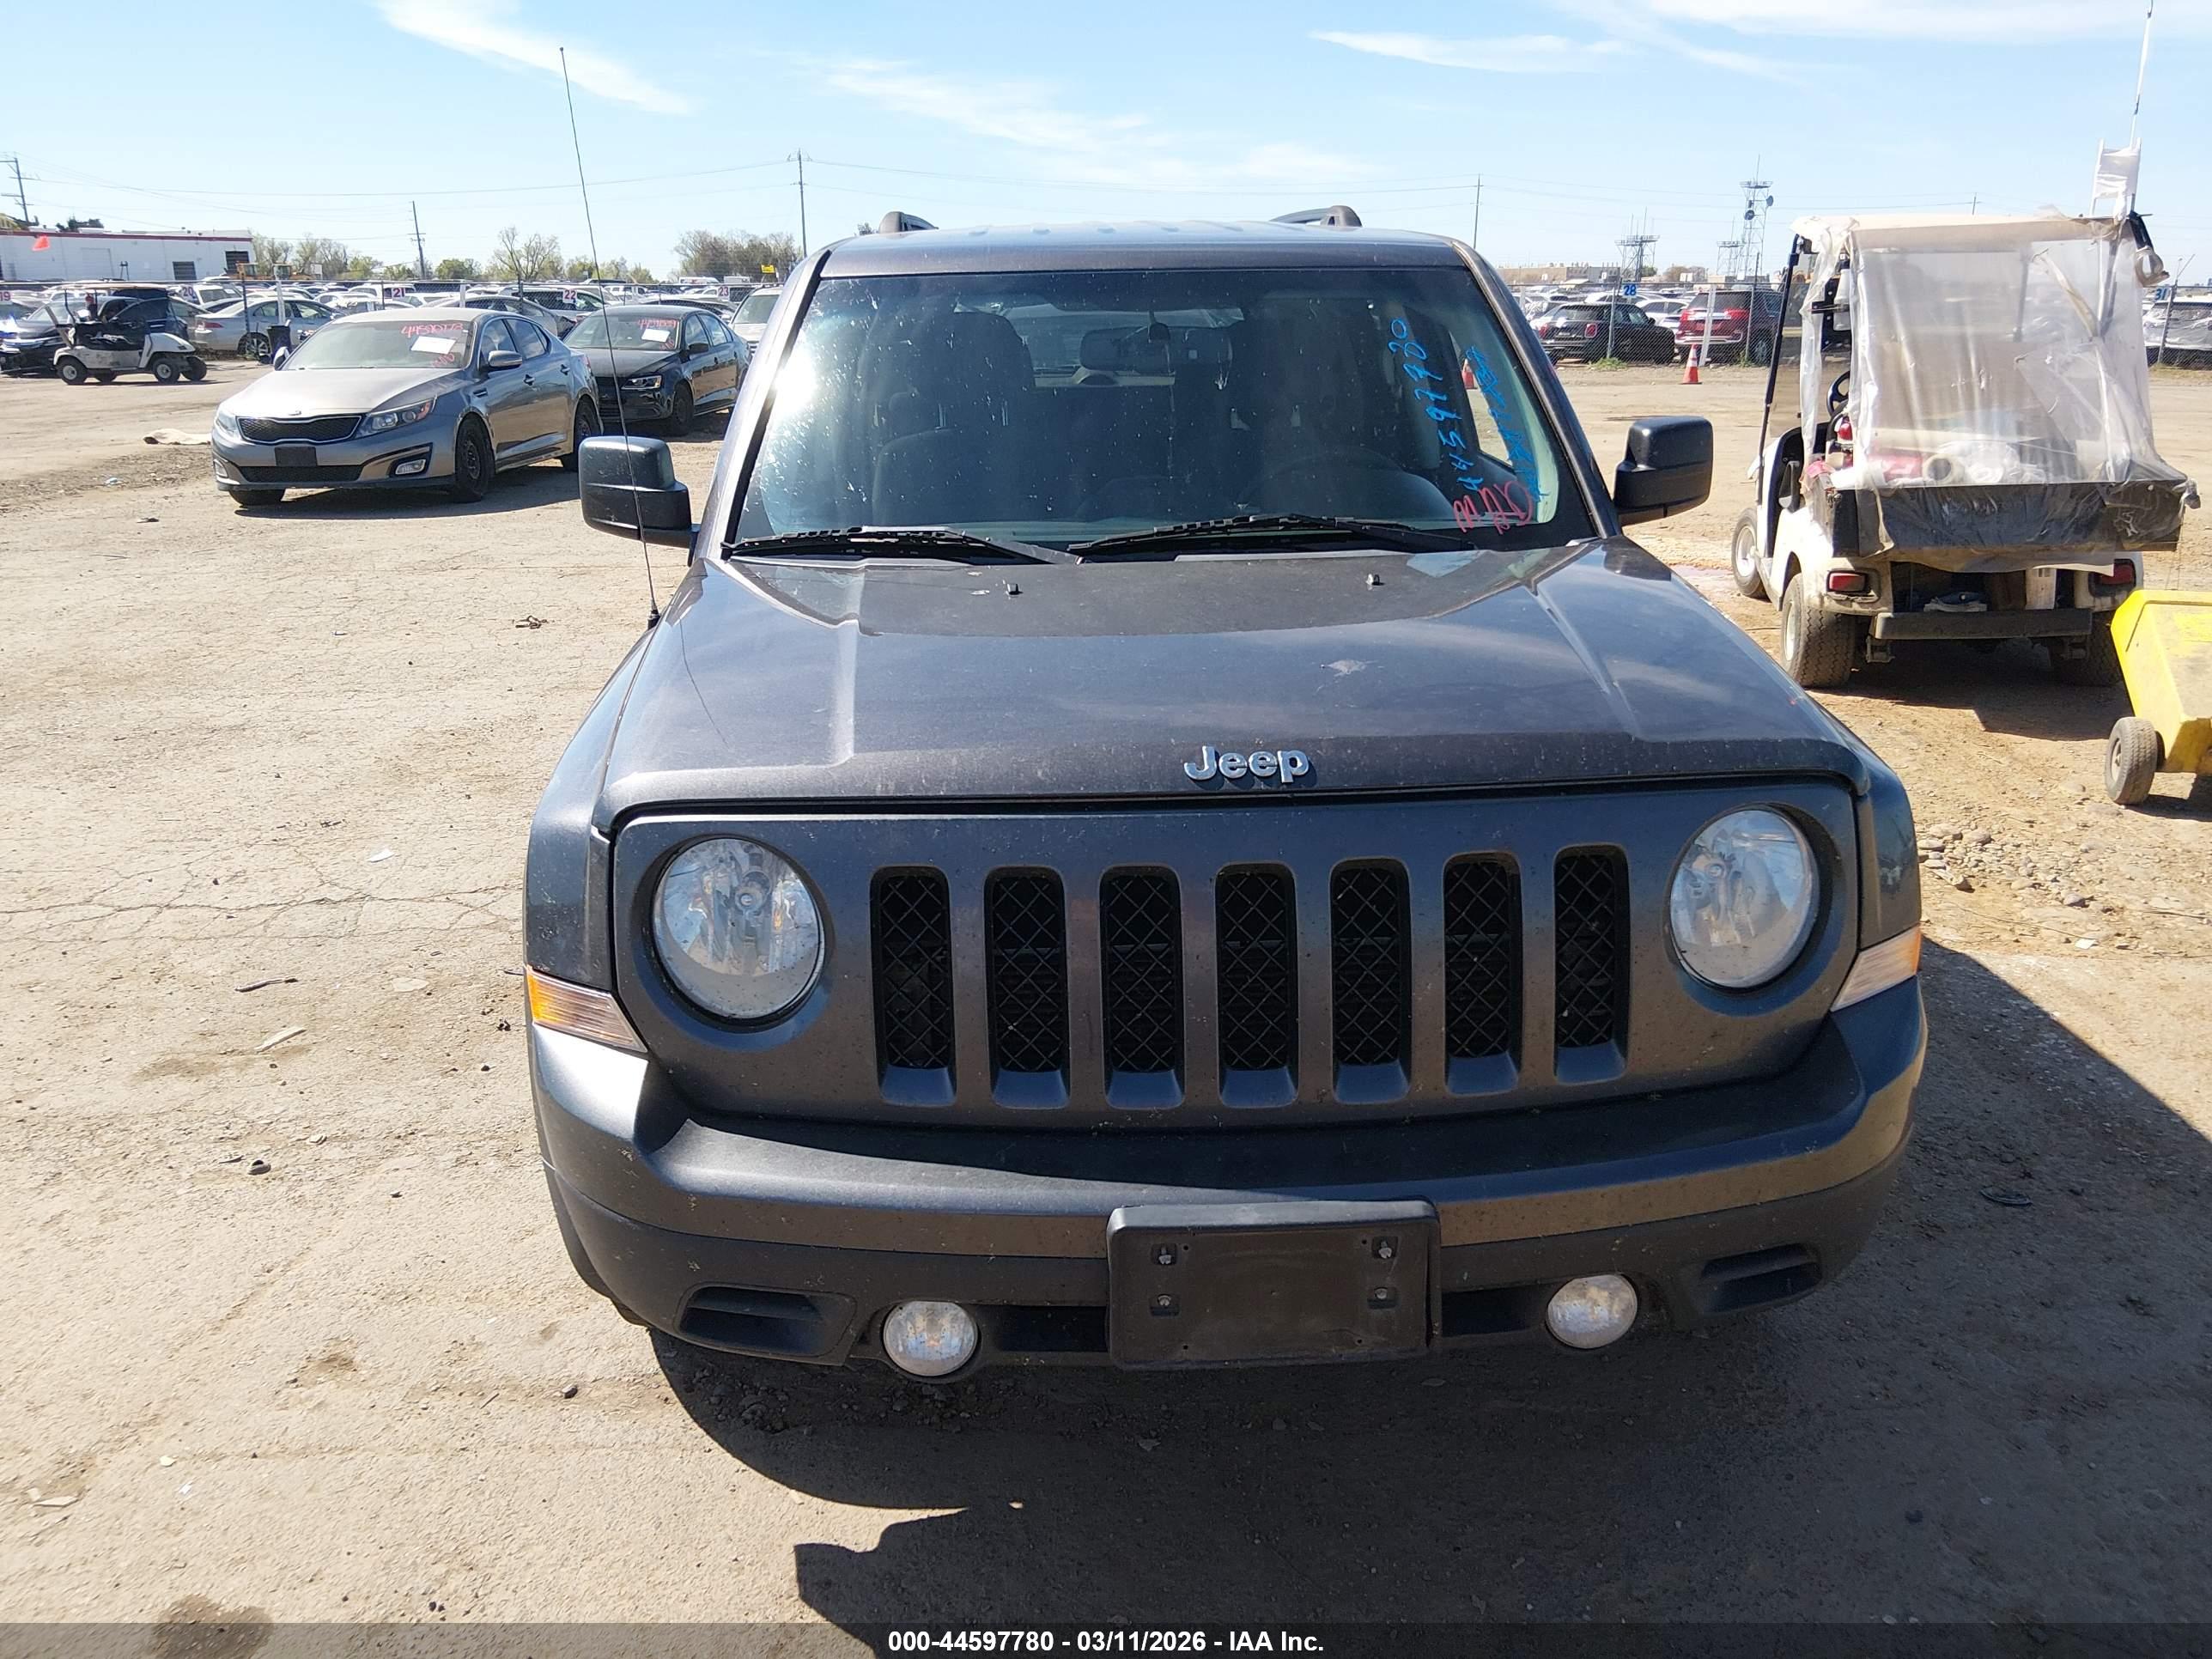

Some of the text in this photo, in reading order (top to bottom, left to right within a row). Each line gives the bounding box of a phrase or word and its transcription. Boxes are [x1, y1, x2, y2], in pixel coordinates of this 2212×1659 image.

[392, 287, 405, 297] 21
[564, 289, 575, 300] 22
[718, 286, 729, 296] 23
[1623, 283, 1636, 296] 28
[2154, 288, 2167, 301] 31
[1184, 745, 1310, 783] Jeep
